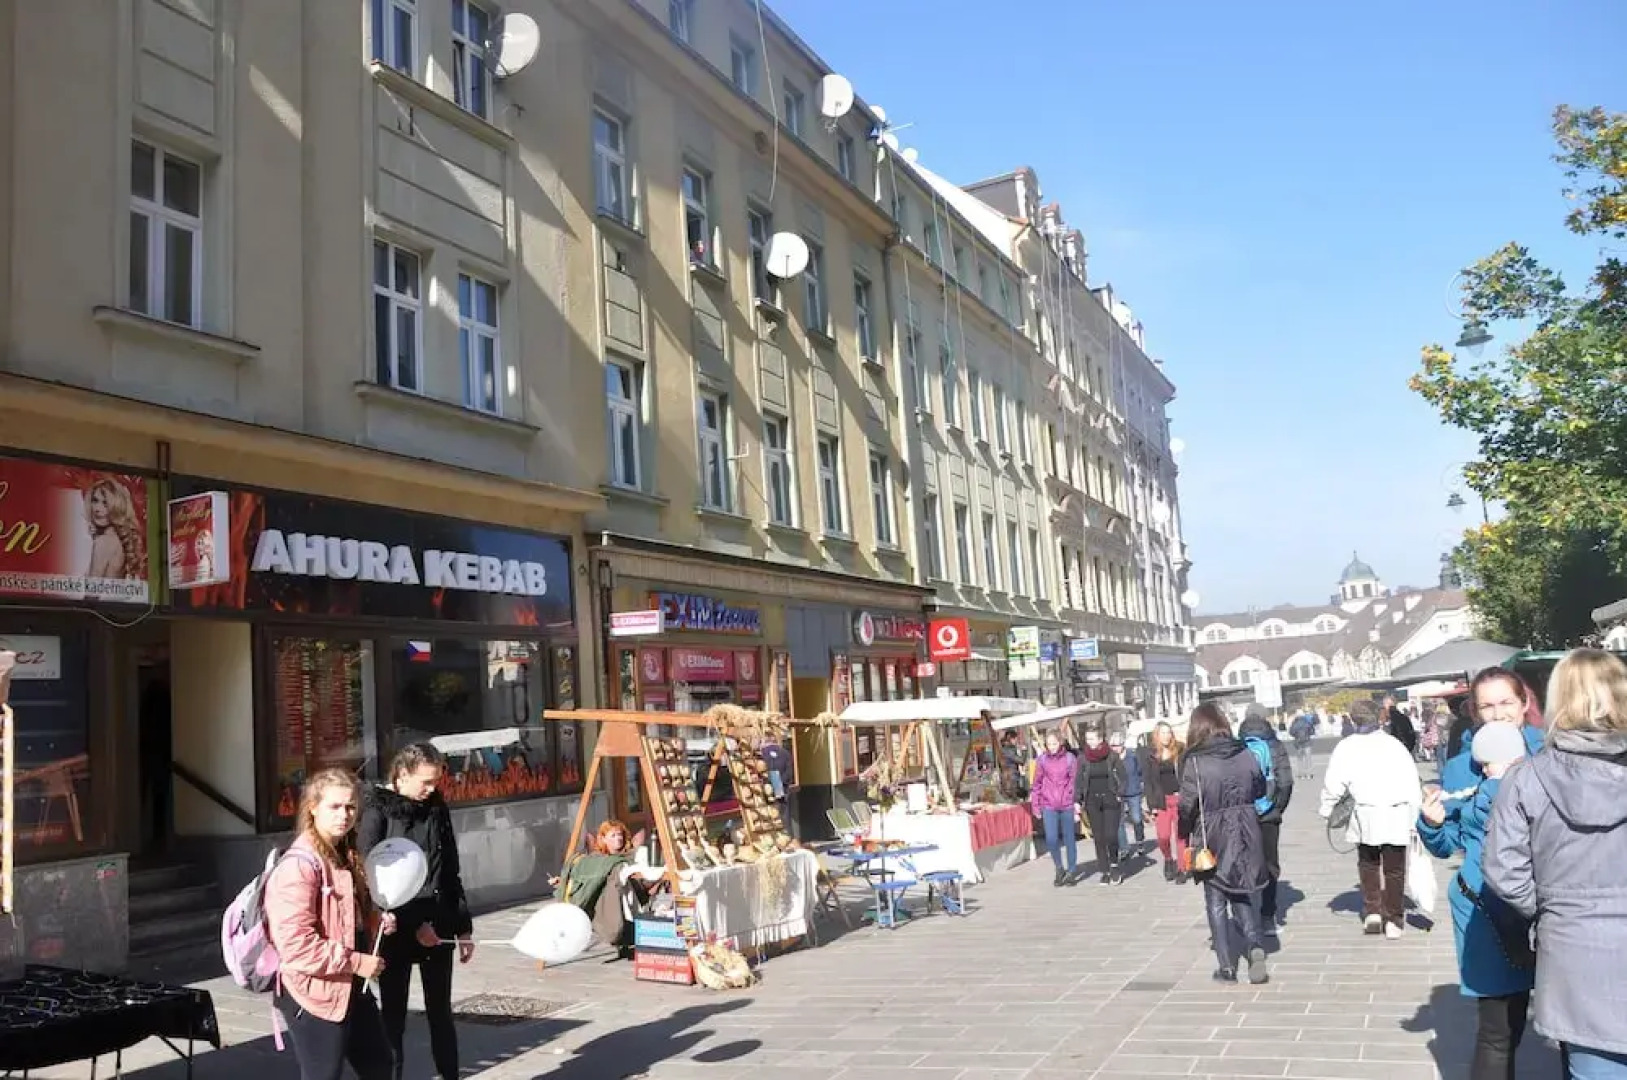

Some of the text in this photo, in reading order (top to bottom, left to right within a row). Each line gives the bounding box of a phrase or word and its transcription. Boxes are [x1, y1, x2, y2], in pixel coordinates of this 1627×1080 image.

[250, 528, 420, 585] AHURA
[423, 549, 547, 596] KEBAB
[30, 578, 38, 589] a
[40, 575, 82, 593] pánské
